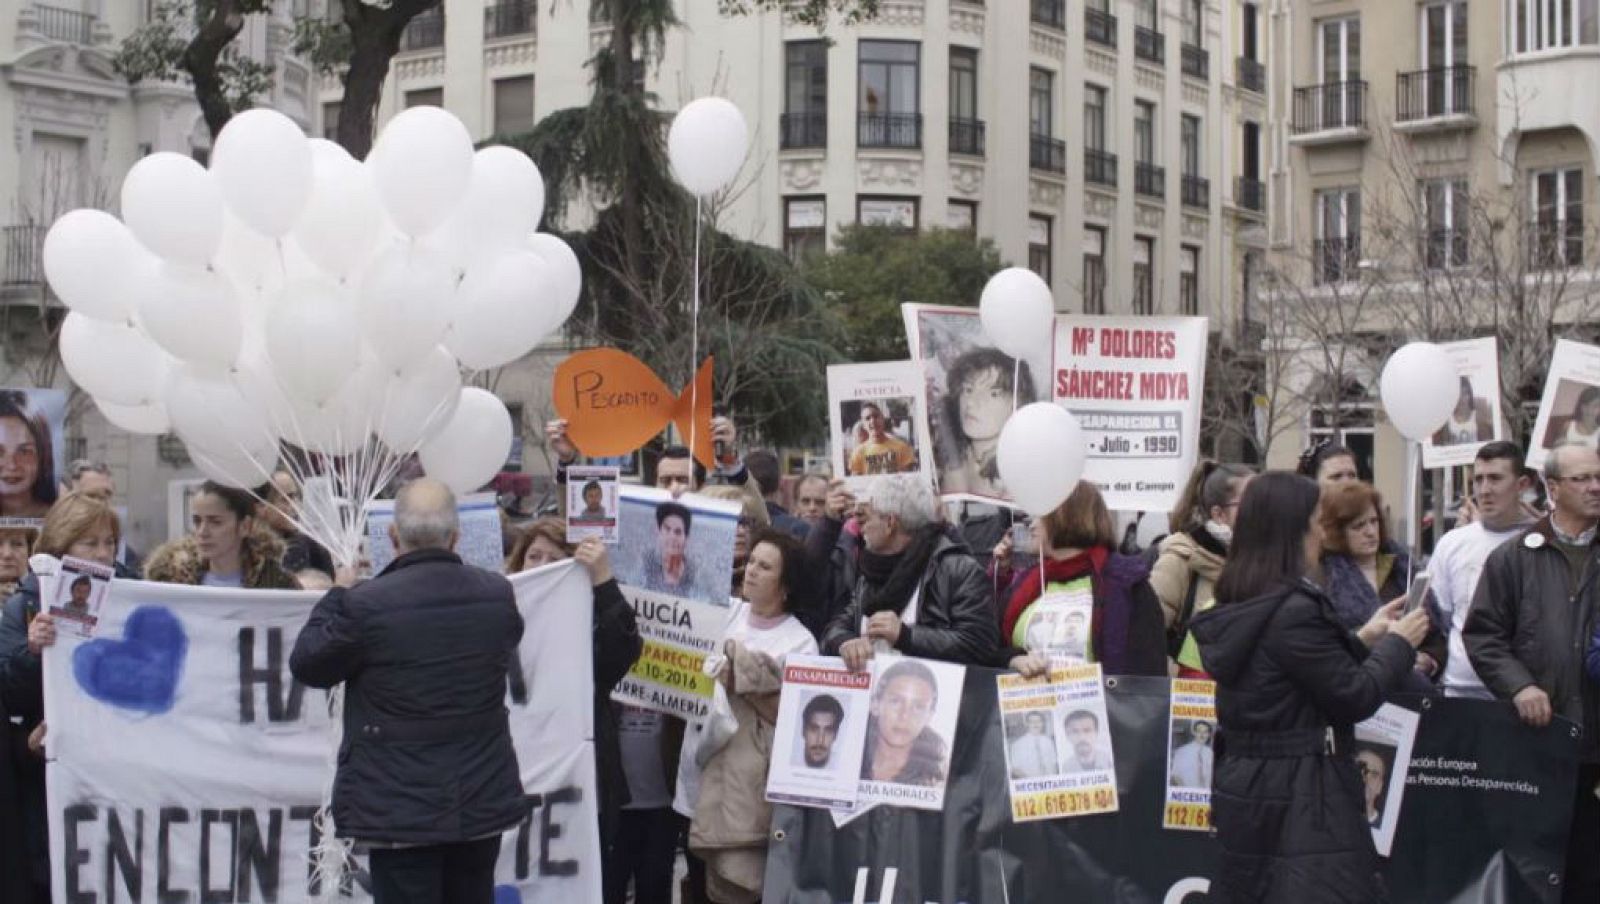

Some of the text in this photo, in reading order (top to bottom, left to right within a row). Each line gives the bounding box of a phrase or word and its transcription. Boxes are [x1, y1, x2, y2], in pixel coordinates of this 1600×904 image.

[1100, 328, 1176, 360] DOLORES
[1056, 364, 1190, 400] SÁNCHEZ MOYA
[1163, 415, 1178, 429] EL
[1099, 436, 1177, 453] Julio 1990
[1114, 482, 1132, 491] del
[1136, 482, 1175, 492] Campo
[788, 668, 868, 686] DESAPARECIDO
[1408, 756, 1478, 772] ación Europea
[1418, 773, 1460, 787] Personas
[1461, 776, 1540, 795] Desaparecidas
[882, 785, 939, 802] MORALES
